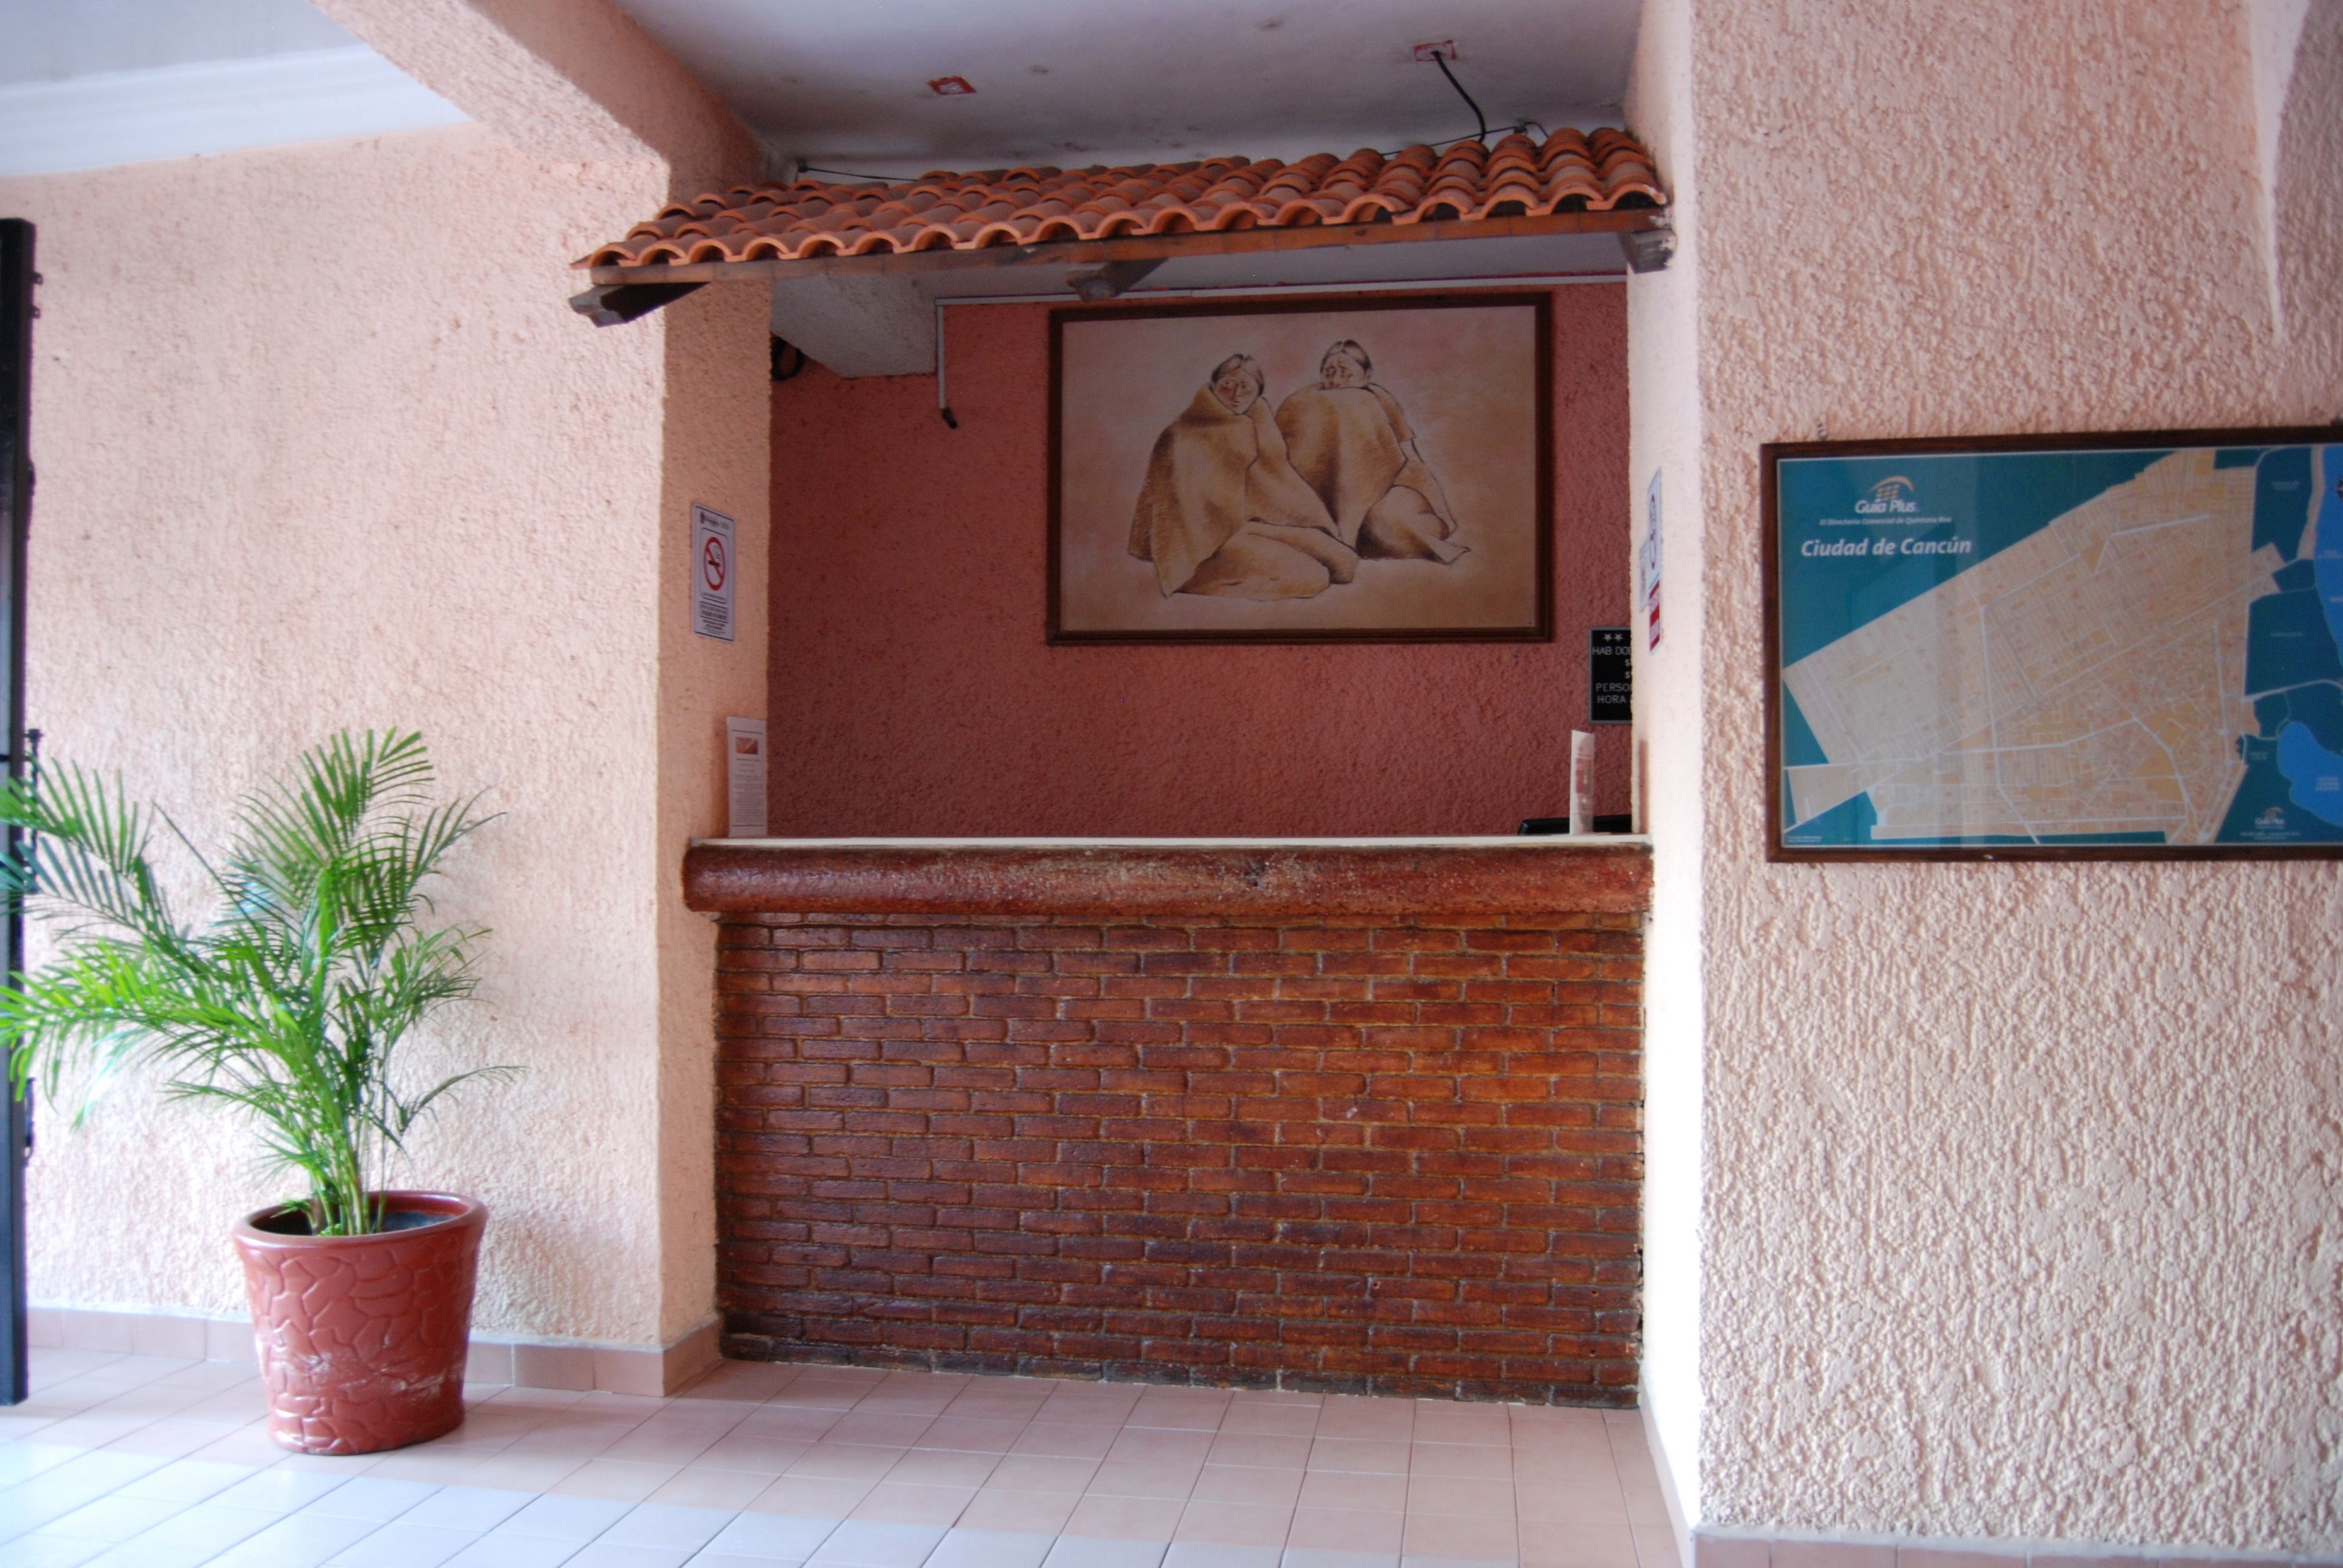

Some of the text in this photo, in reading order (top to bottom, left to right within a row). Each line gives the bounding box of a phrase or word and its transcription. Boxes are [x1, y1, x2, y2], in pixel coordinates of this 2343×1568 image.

[1889, 499, 1917, 513] Plus
[1801, 536, 1971, 556] Ciudad de Cancún
[1592, 646, 1612, 655] HAB
[1596, 683, 1632, 692] PERSO
[1597, 694, 1627, 703] HORA
